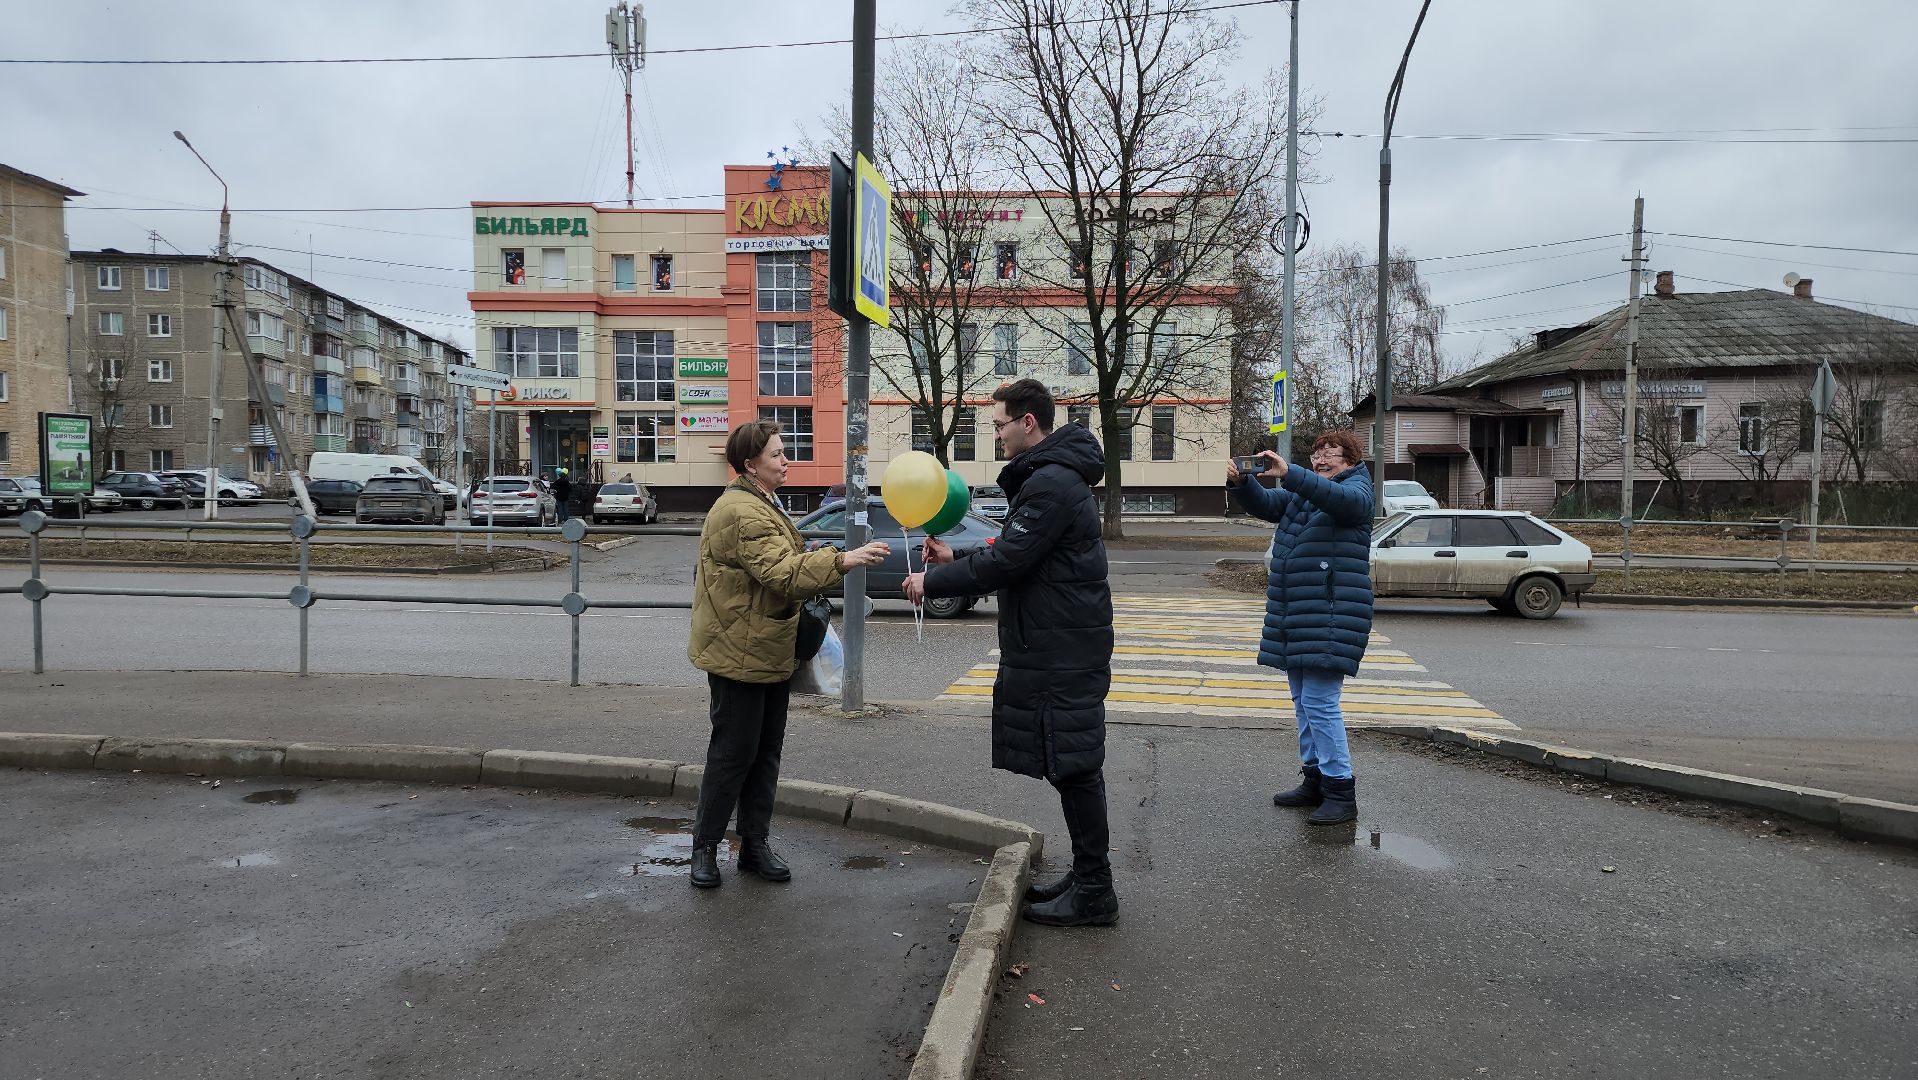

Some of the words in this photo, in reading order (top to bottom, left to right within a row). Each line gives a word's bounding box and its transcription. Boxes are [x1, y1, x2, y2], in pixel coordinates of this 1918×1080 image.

[736, 191, 831, 233] КОСМО
[475, 216, 589, 237] БИЛЬЯРД
[679, 361, 728, 373] БИЛЬЯР
[521, 387, 571, 400] ДИКСИ
[1606, 384, 1703, 394] НЕИЖИМОСТИ
[698, 416, 728, 424] магни
